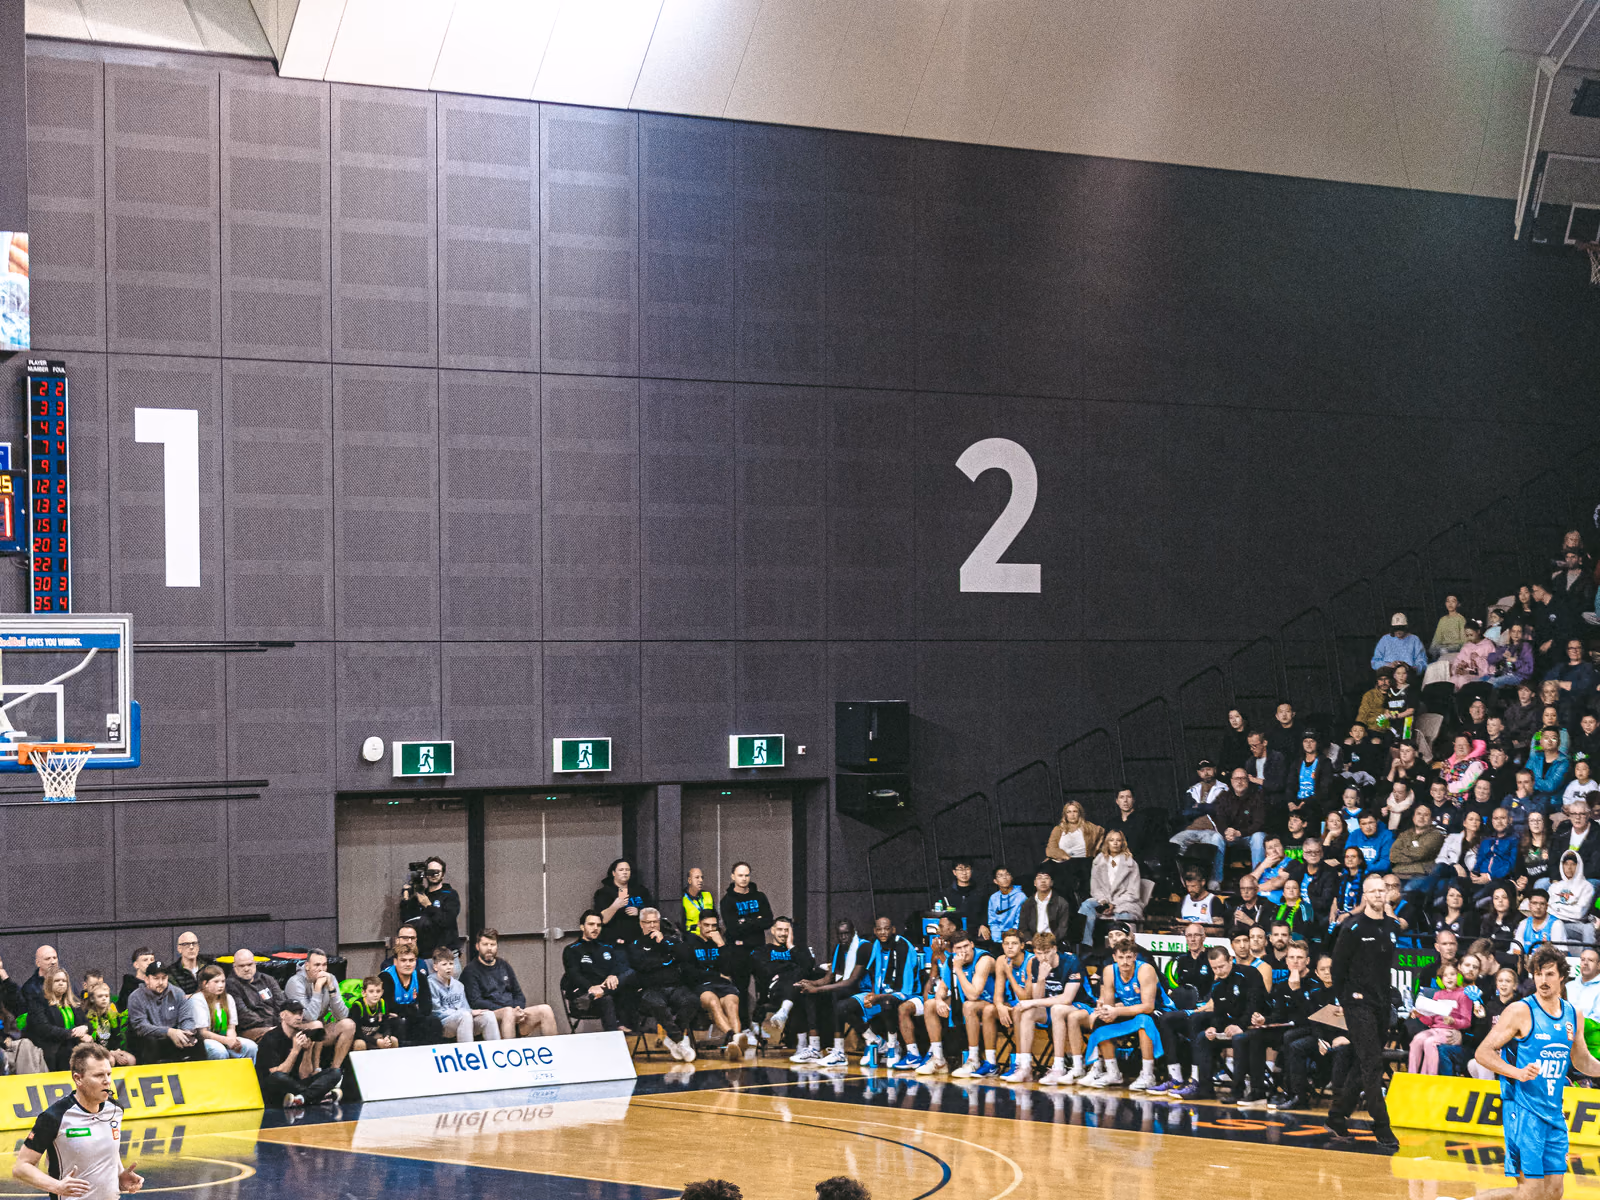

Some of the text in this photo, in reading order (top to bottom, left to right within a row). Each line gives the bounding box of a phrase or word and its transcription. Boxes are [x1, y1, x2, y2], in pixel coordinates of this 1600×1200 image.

[40, 381, 64, 396] 2 2
[40, 401, 64, 416] 3 3
[41, 421, 64, 436] 4 2
[42, 440, 65, 455] 7 4
[41, 460, 49, 473] 9
[37, 479, 66, 494] 12 2
[134, 407, 201, 588] 1
[37, 498, 66, 513] 13 2
[955, 437, 1041, 593] 2
[38, 518, 66, 532] 15 1
[33, 538, 66, 553] 20 3
[33, 557, 67, 572] 22 1
[34, 576, 67, 591] 30 3
[34, 596, 68, 611] 35 4
[45, 637, 57, 646] YOU
[432, 1044, 488, 1073] intel
[1446, 1091, 1502, 1126] JB
